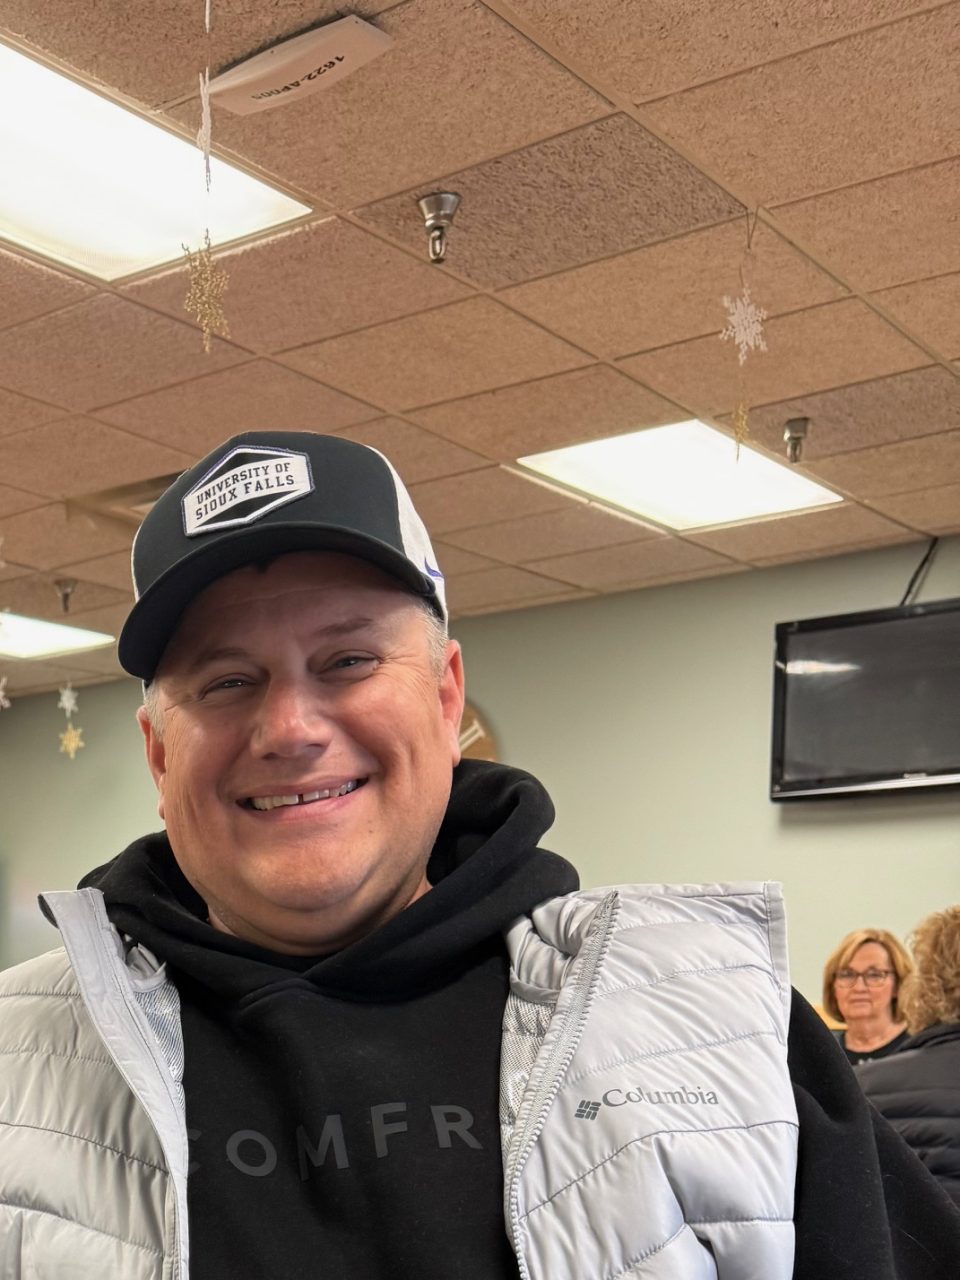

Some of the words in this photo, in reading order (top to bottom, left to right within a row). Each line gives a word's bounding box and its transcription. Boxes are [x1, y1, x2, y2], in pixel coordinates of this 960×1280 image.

[195, 488, 238, 520] SIOUX
[243, 474, 295, 495] FALLS
[197, 465, 269, 504] UNIVERSITY
[275, 463, 291, 473] OF
[602, 1086, 719, 1108] Columbia
